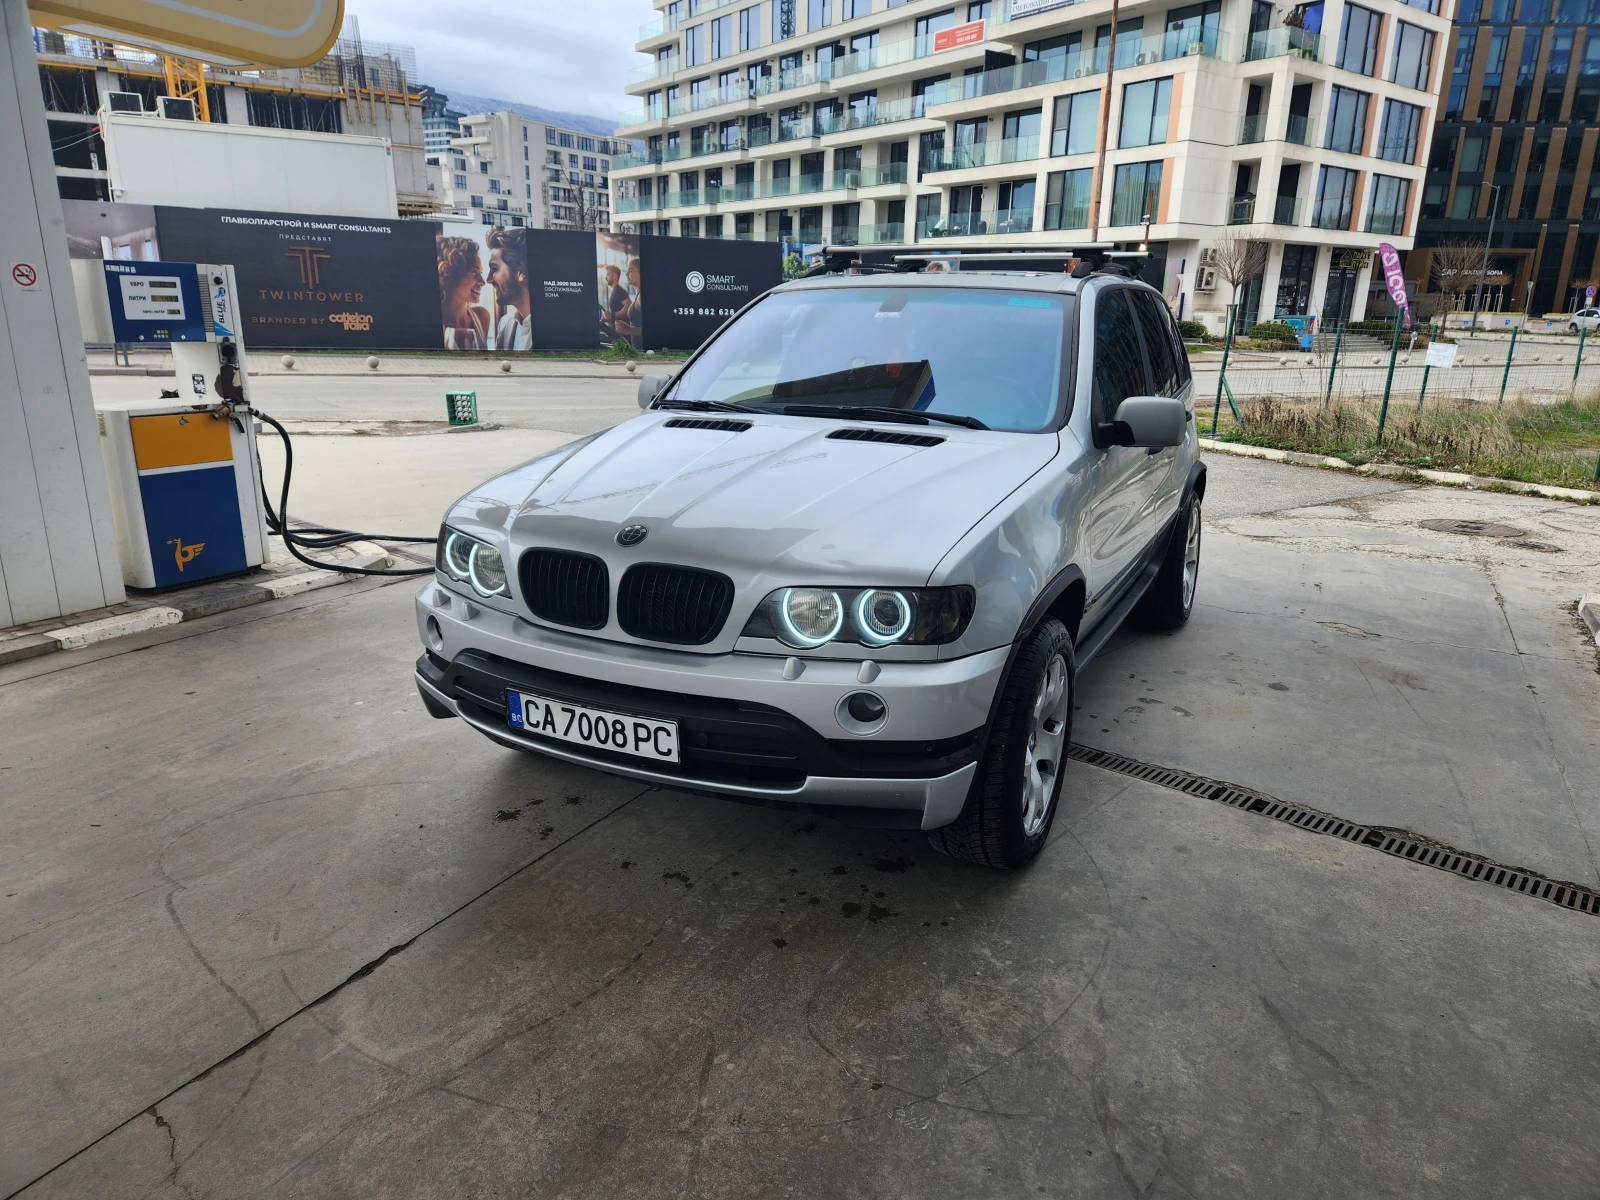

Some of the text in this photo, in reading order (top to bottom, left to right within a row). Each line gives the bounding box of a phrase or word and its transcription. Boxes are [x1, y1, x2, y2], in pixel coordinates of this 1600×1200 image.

[221, 215, 302, 228] ГЛАВБОЛГАРСТРОЙ
[311, 221, 392, 234] SMART CONSULTANTS
[279, 233, 332, 242] ПРЕДСТАВЯТ
[1441, 268, 1457, 276] SAP
[706, 274, 735, 284] SMART
[706, 283, 749, 291] CONSULTANTS
[259, 289, 364, 303] TWINTOWER
[216, 301, 225, 324] BLUE
[673, 307, 735, 316] +359 882 628
[252, 316, 306, 325] BRANDED
[311, 317, 325, 325] BY
